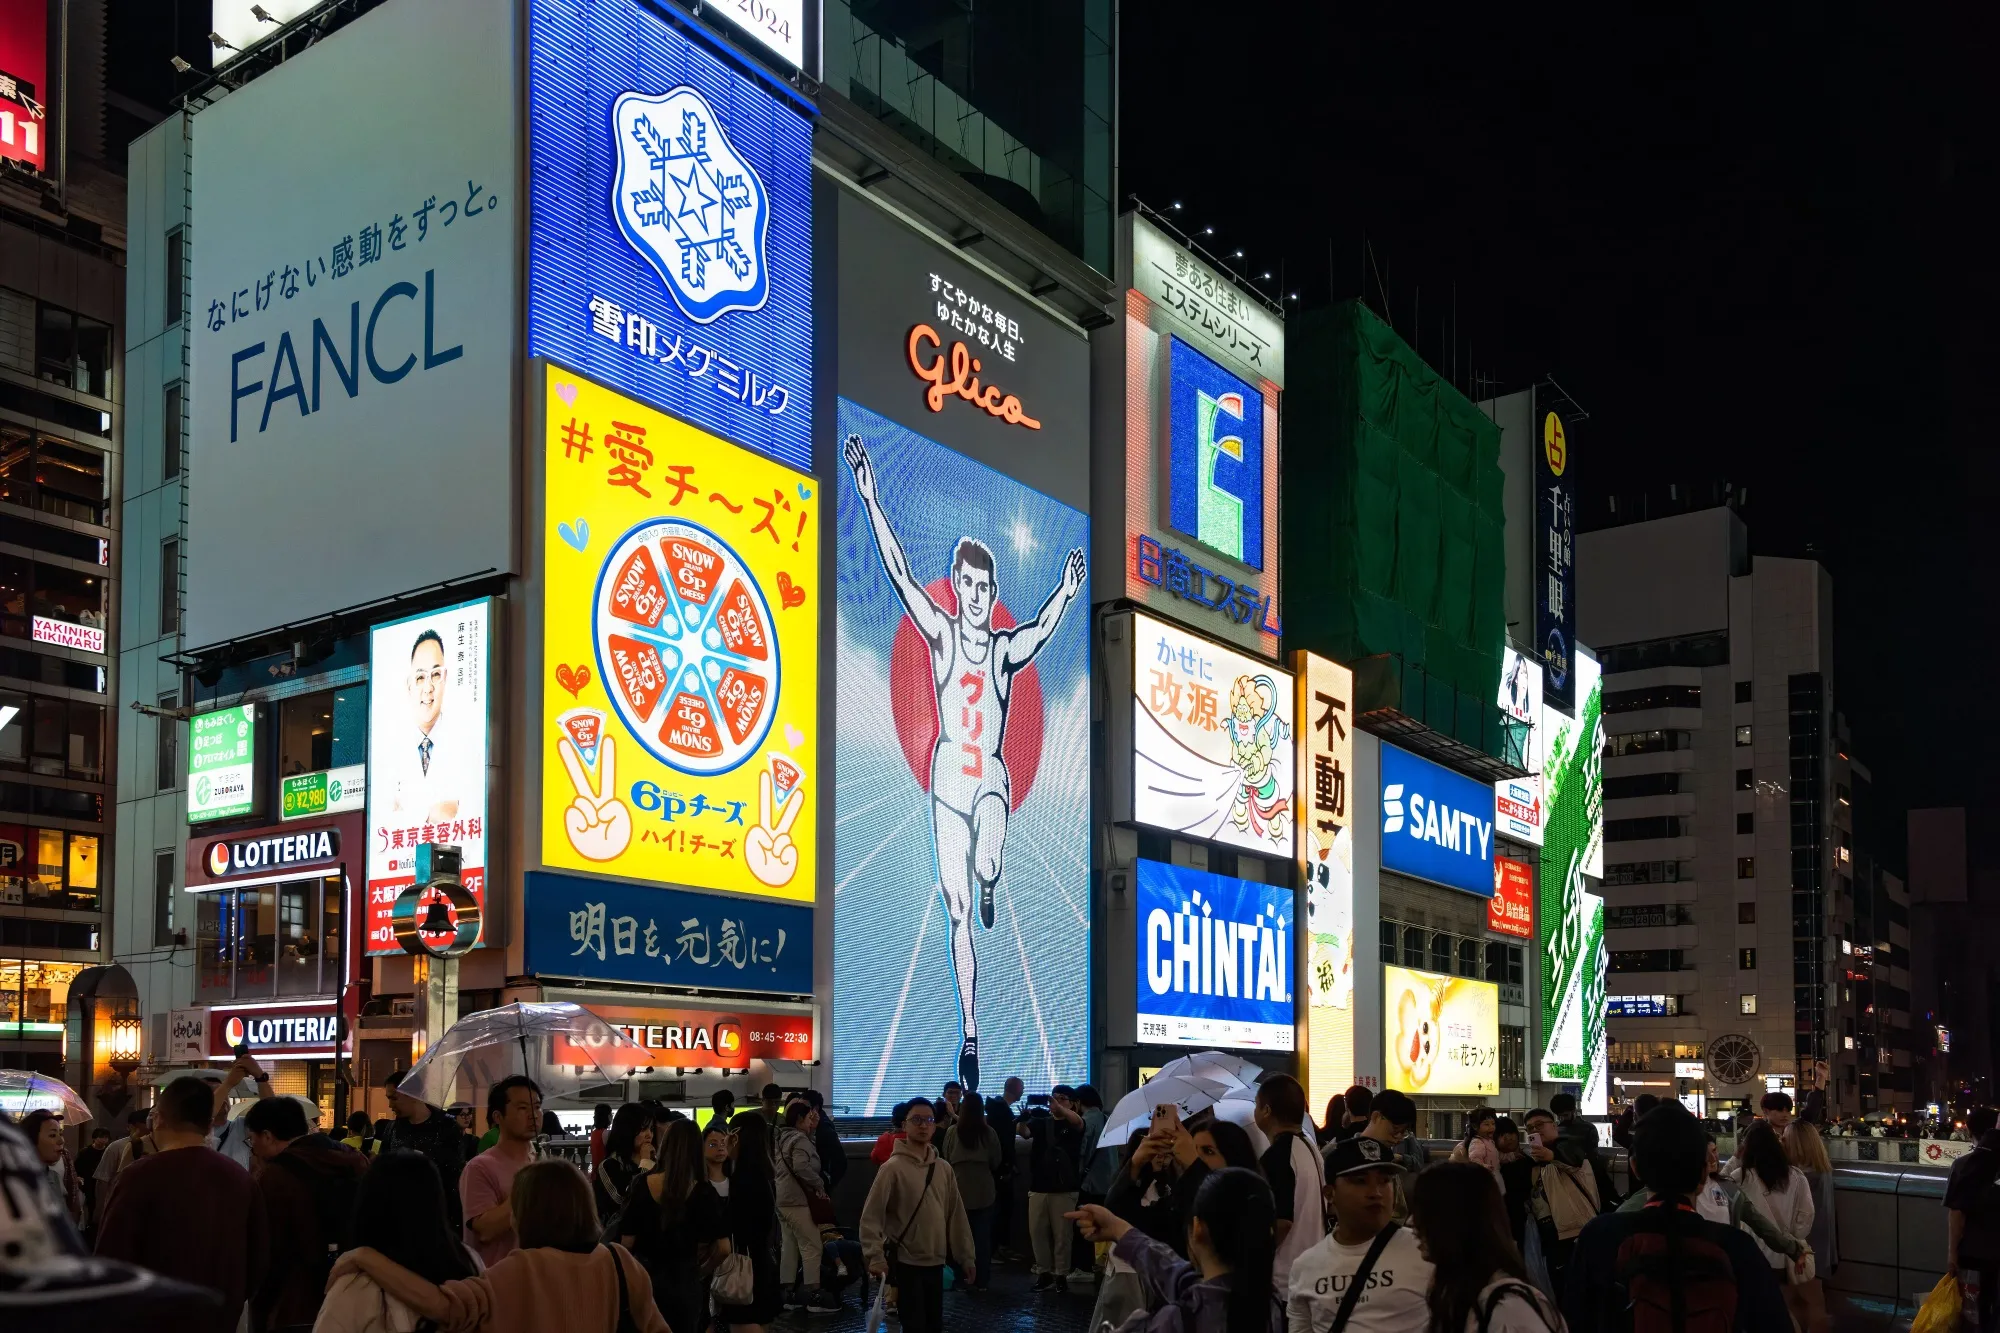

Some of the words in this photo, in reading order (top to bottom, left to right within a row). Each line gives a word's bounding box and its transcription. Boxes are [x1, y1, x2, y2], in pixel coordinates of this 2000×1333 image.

[207, 180, 498, 332] なにげない感動をずっと。
[1175, 250, 1250, 321] 夢ある住まい
[929, 272, 1024, 344] すこやかな毎日、
[1161, 280, 1262, 368] エステムシリーズ
[937, 300, 1016, 362] ゆたかな人生
[230, 268, 464, 444] FANCL
[588, 293, 789, 415] 雪印メグミルク
[908, 323, 1041, 430] Glico
[1548, 415, 1564, 472] 占
[672, 542, 717, 570] SNOW
[615, 554, 648, 609] SNOW
[678, 567, 707, 591] 6P
[679, 587, 706, 603] CHEESE
[1139, 533, 1282, 637] 日商エステム
[635, 584, 658, 616] 6P
[648, 594, 667, 626] CHEESE
[34, 619, 102, 642] YAKINIKU
[718, 614, 735, 650] CHEESE
[726, 608, 744, 646] 6P
[737, 593, 765, 649] SNOW
[34, 629, 102, 650] RIKIMARU
[612, 648, 646, 708] SNOW
[637, 650, 656, 690] 6P
[648, 647, 666, 684] CHEESE
[678, 695, 706, 710] CHEESE
[718, 670, 735, 700] CHEESE
[726, 678, 747, 710] 6P
[1149, 667, 1219, 733] 改源
[572, 718, 595, 729] SNOW
[676, 706, 707, 728] 6P
[740, 684, 763, 737] SNOW
[959, 668, 986, 779] グリコ
[578, 732, 594, 741] 6P
[668, 728, 713, 753] SNOW
[214, 784, 245, 796] ZUBORAYA
[296, 788, 326, 808] ¥2,980
[391, 816, 482, 850] 東京美容外科
[641, 828, 738, 860] ハイ!チーズ
[1409, 792, 1492, 862] SAMTY
[233, 830, 333, 868] LOTTERIA
[464, 876, 483, 893] 2F
[568, 901, 787, 973] 明日を、元気に!
[1147, 896, 1286, 1003] CHINTAI
[247, 1016, 338, 1044] LOTTERIA
[568, 1023, 713, 1050] LOTTERIA
[1314, 1269, 1394, 1295] GUSS
